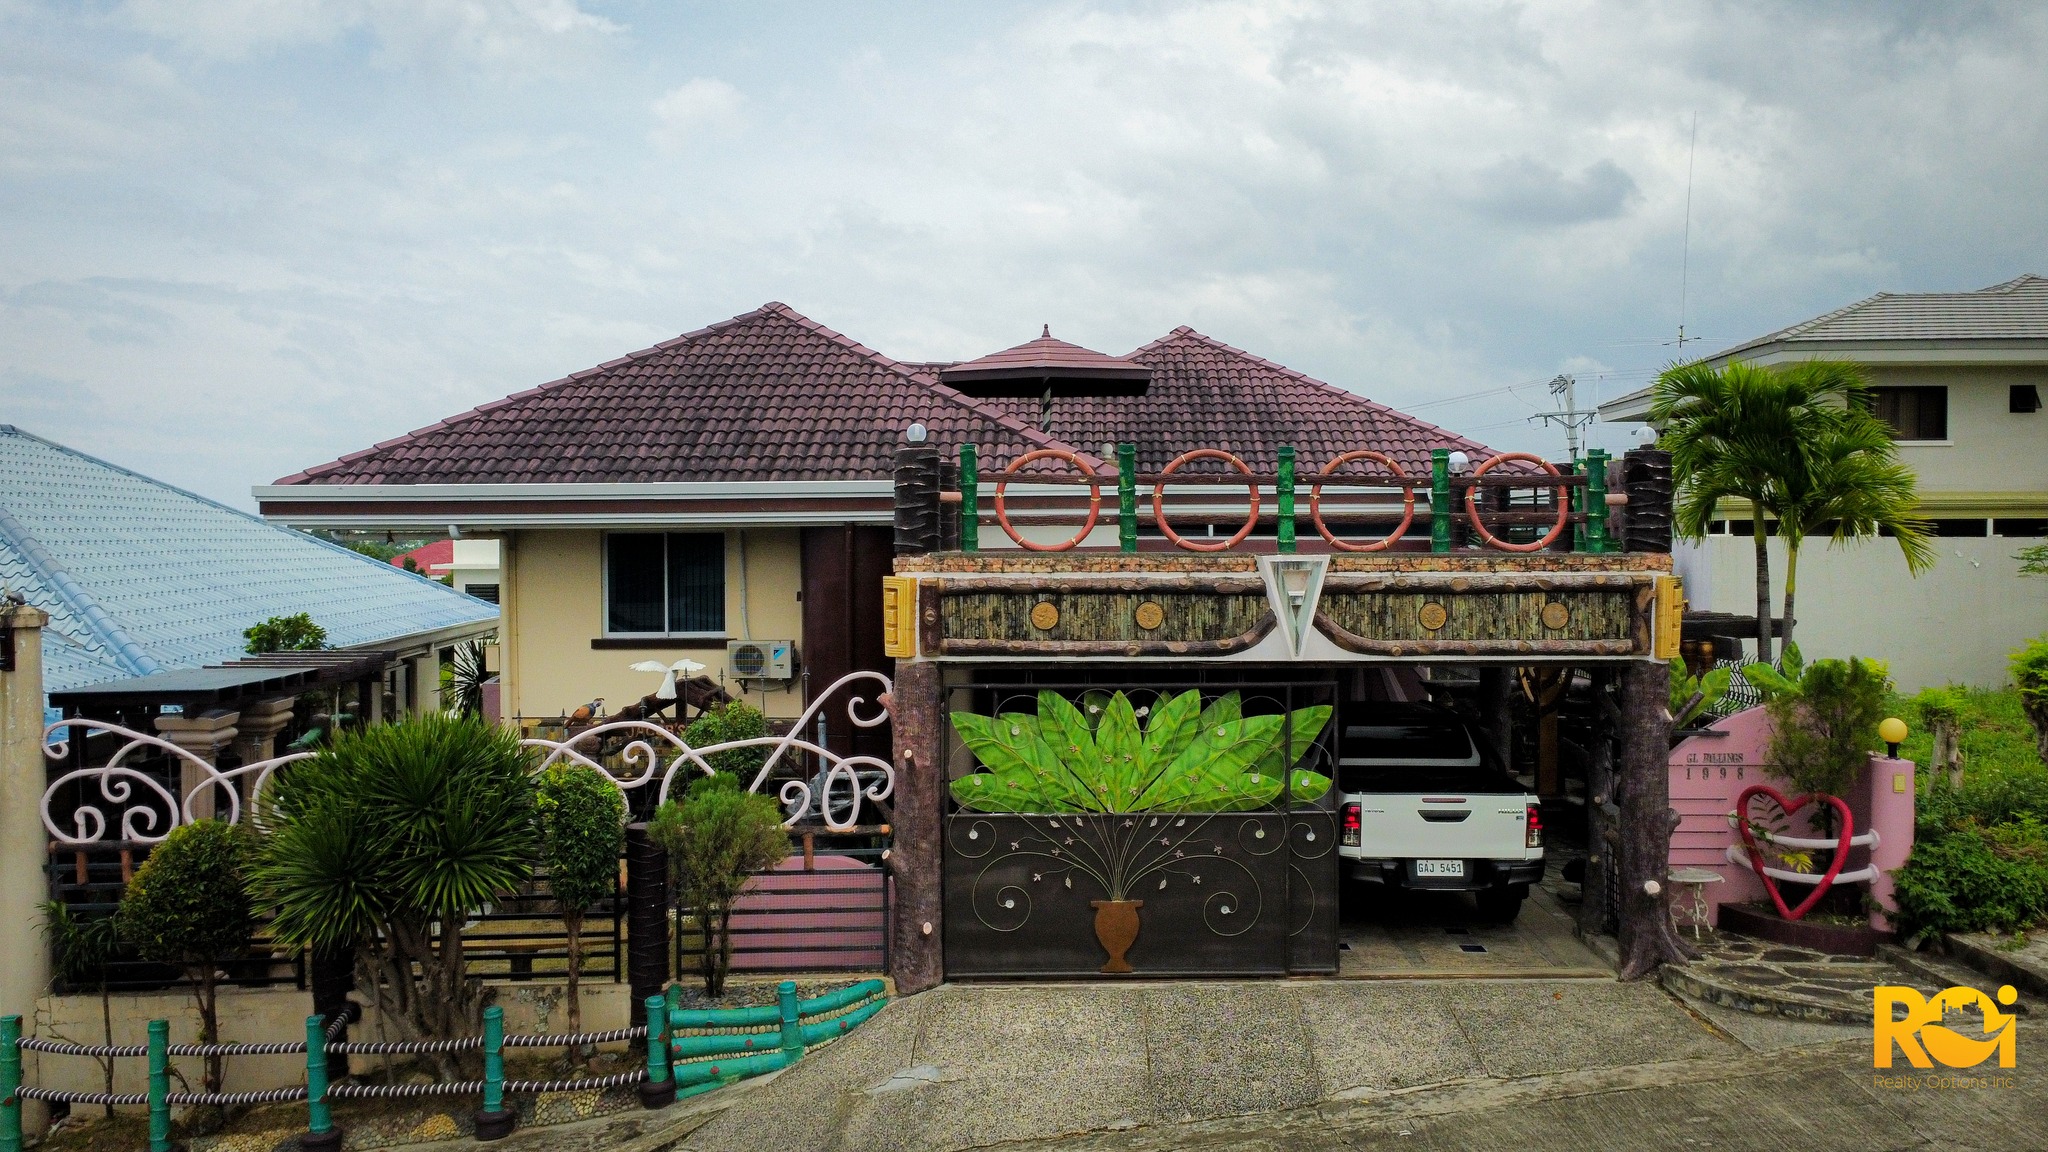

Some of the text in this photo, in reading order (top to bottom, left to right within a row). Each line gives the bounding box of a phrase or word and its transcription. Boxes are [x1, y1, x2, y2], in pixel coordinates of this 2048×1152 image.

[1686, 767, 1744, 780] 1998
[1418, 863, 1462, 873] GAJ 5451
